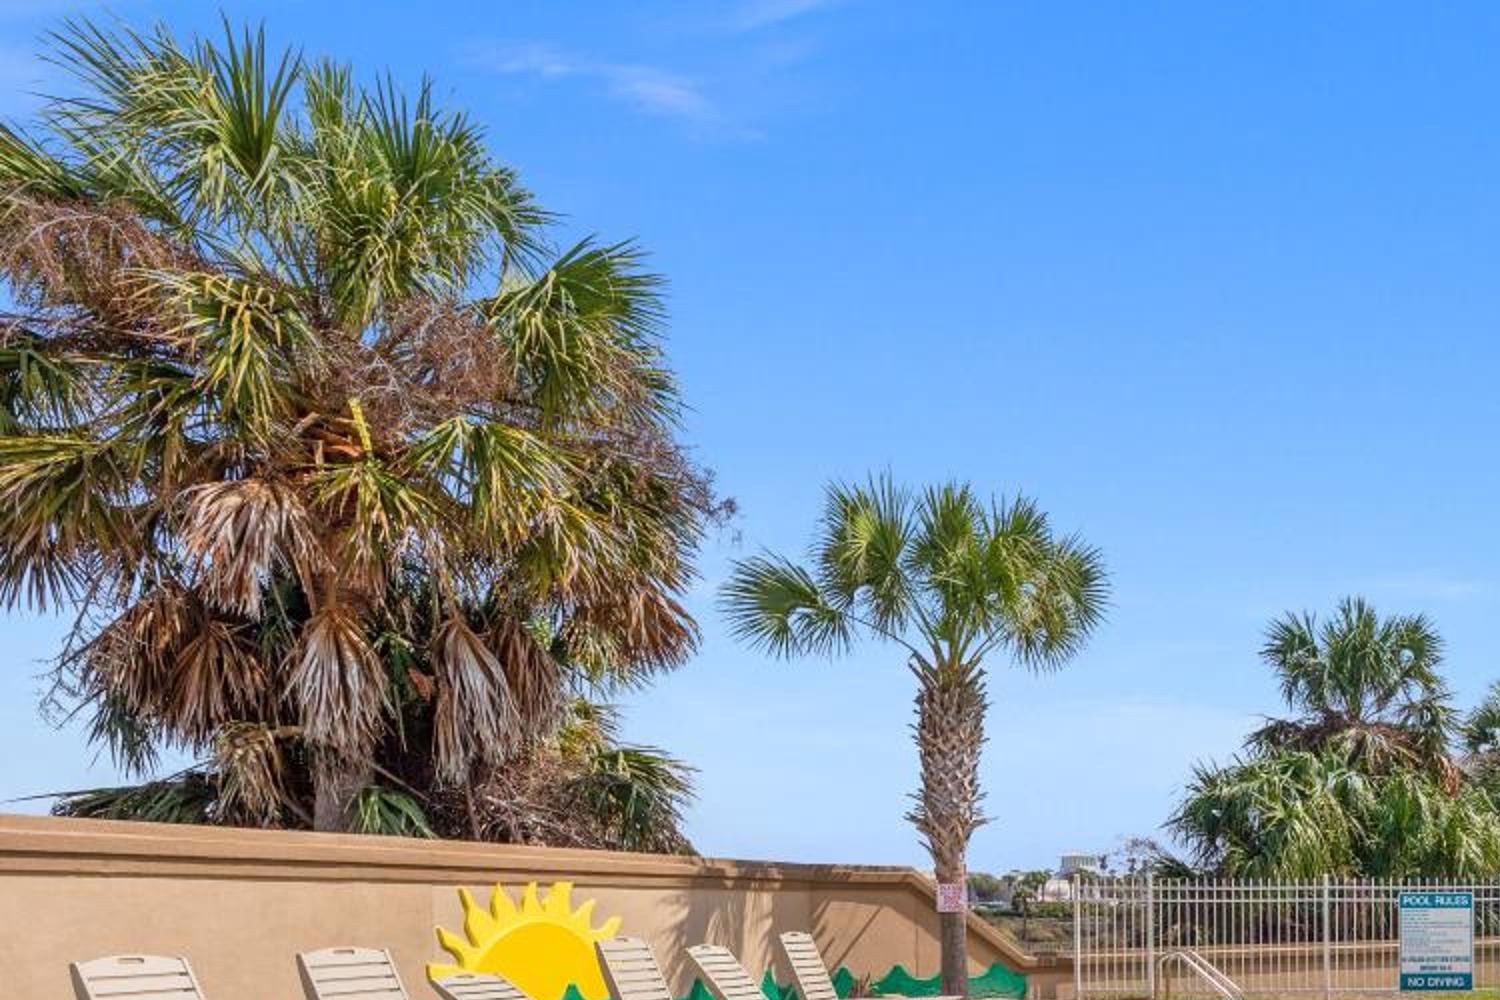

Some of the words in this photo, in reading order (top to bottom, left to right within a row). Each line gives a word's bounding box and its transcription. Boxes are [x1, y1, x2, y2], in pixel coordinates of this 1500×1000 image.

[1403, 895, 1429, 905] POOL
[1435, 895, 1469, 905] RULES
[1407, 977, 1424, 987] NO
[1427, 977, 1465, 987] DIVING
